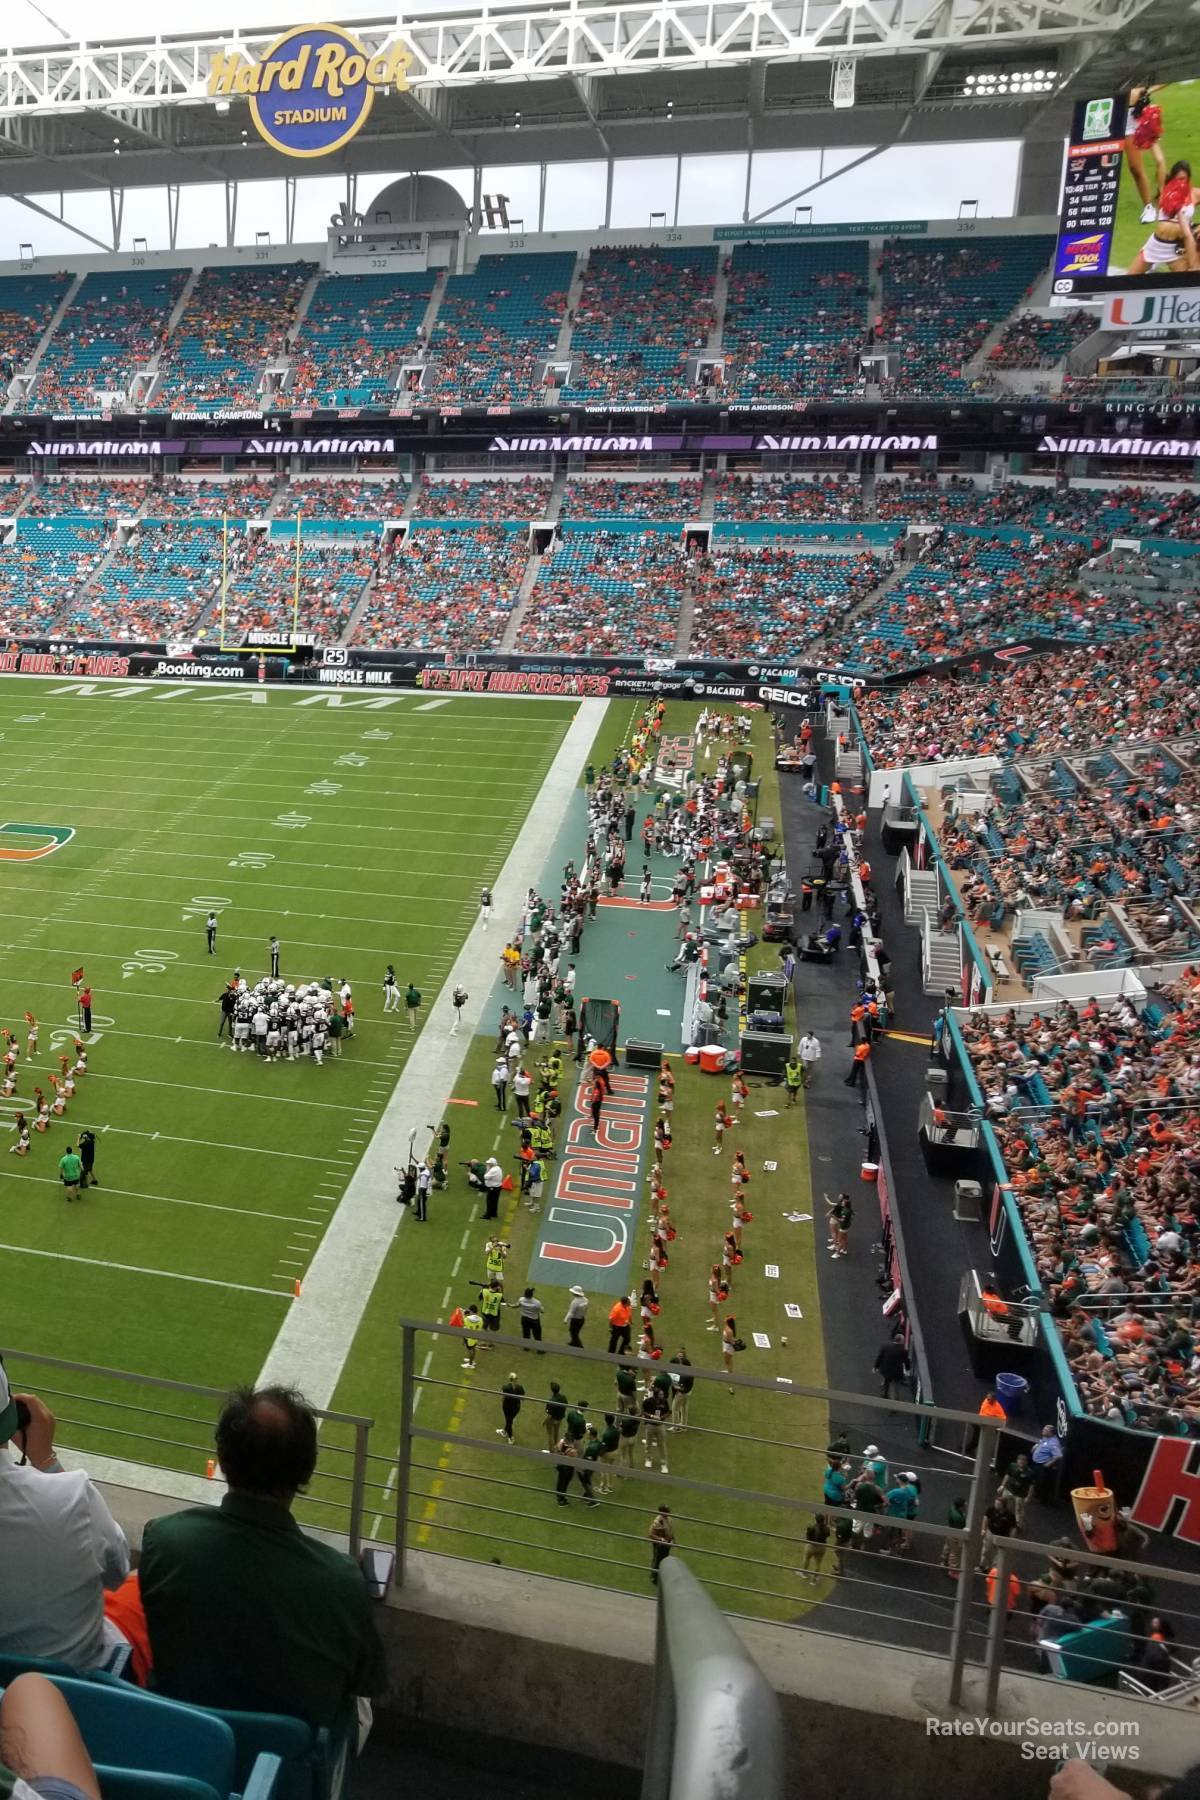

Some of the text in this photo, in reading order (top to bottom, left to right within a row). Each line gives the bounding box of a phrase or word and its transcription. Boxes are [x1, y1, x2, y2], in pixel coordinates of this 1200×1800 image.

[209, 39, 414, 97] Hard Rock
[274, 107, 346, 125] STADIUM
[1074, 174, 1080, 182] 7
[1104, 193, 1113, 201] 27
[1101, 205, 1113, 213] 101
[957, 223, 975, 231] 336
[1066, 220, 1076, 228] 90
[666, 233, 683, 241] 334
[1075, 254, 1099, 263] TOOL
[1057, 282, 1070, 291] CC
[1106, 403, 1145, 413] RING
[171, 410, 263, 421] NATIONAL CHAMPIONS
[248, 632, 317, 646] MUSCLE MILK
[327, 650, 344, 663] 25
[157, 661, 244, 678] Booking.com
[319, 669, 393, 684] MUSCLE MILK
[46, 684, 453, 710] MIAMI
[706, 686, 745, 697] BACARDÍ
[361, 731, 393, 740] 10
[333, 755, 370, 767] 20
[304, 782, 343, 796] 30
[271, 814, 312, 829] 40
[227, 852, 275, 869] 50
[181, 896, 232, 915] 40
[121, 949, 179, 973] 30
[50, 1014, 115, 1045] 20
